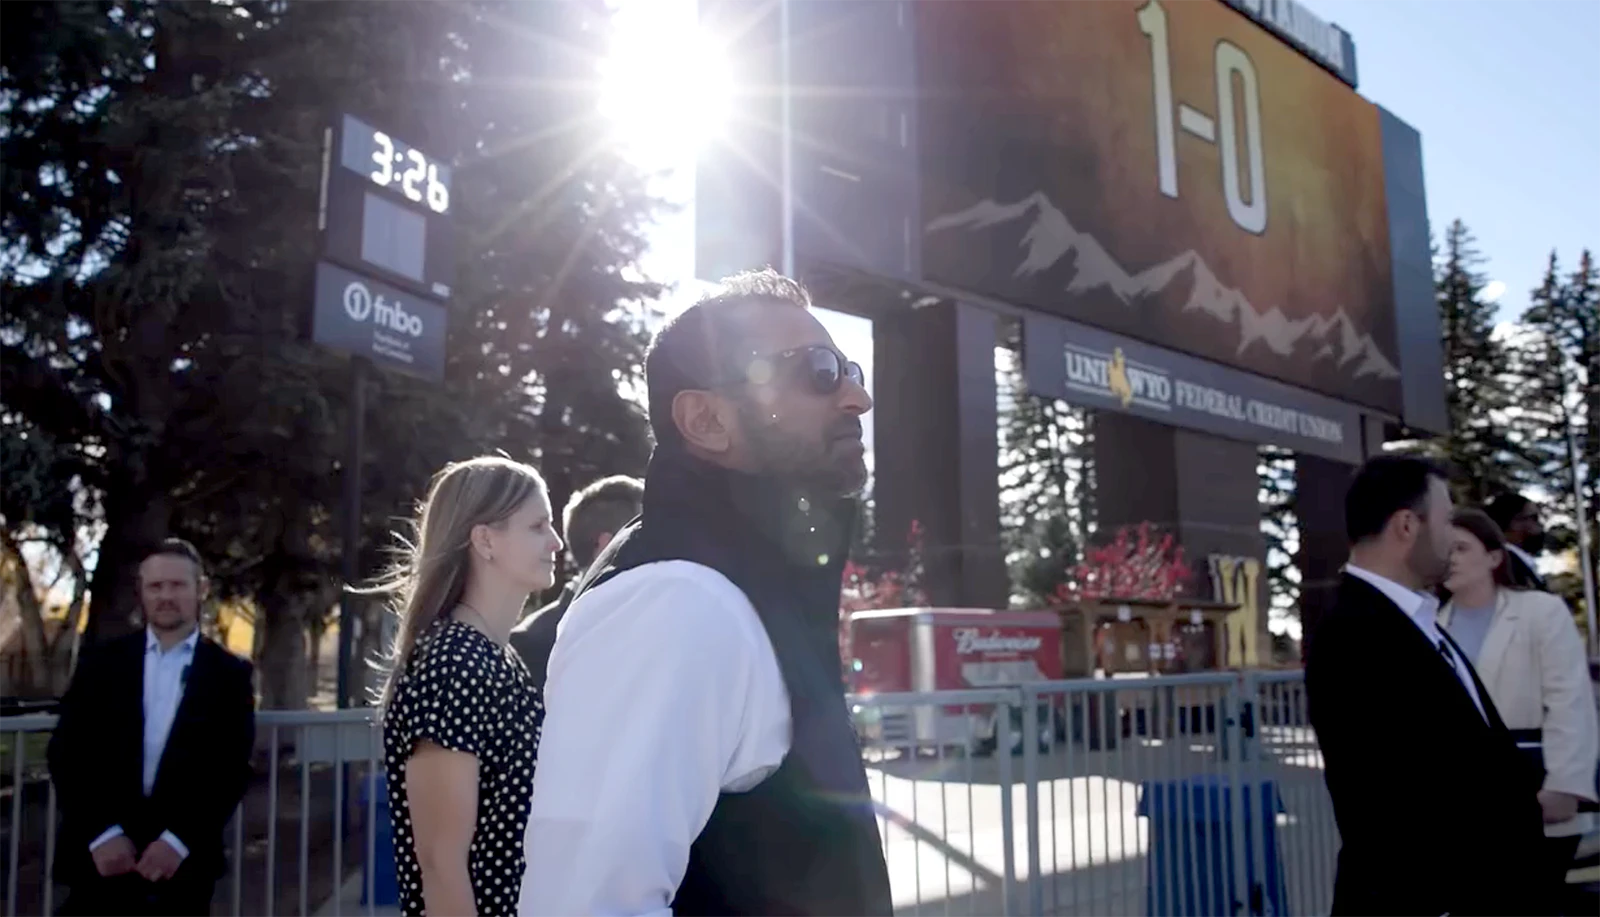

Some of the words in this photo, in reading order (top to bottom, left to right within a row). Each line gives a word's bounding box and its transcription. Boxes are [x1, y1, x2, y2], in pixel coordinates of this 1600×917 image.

[1136, 0, 1268, 236] 1-0
[371, 131, 449, 213] 3:26
[373, 295, 423, 336] fnbo
[1175, 379, 1246, 421] FEDERAL
[1247, 400, 1299, 434] CREDIT
[1299, 412, 1343, 444] UNION
[952, 627, 1042, 654] Budweiser
